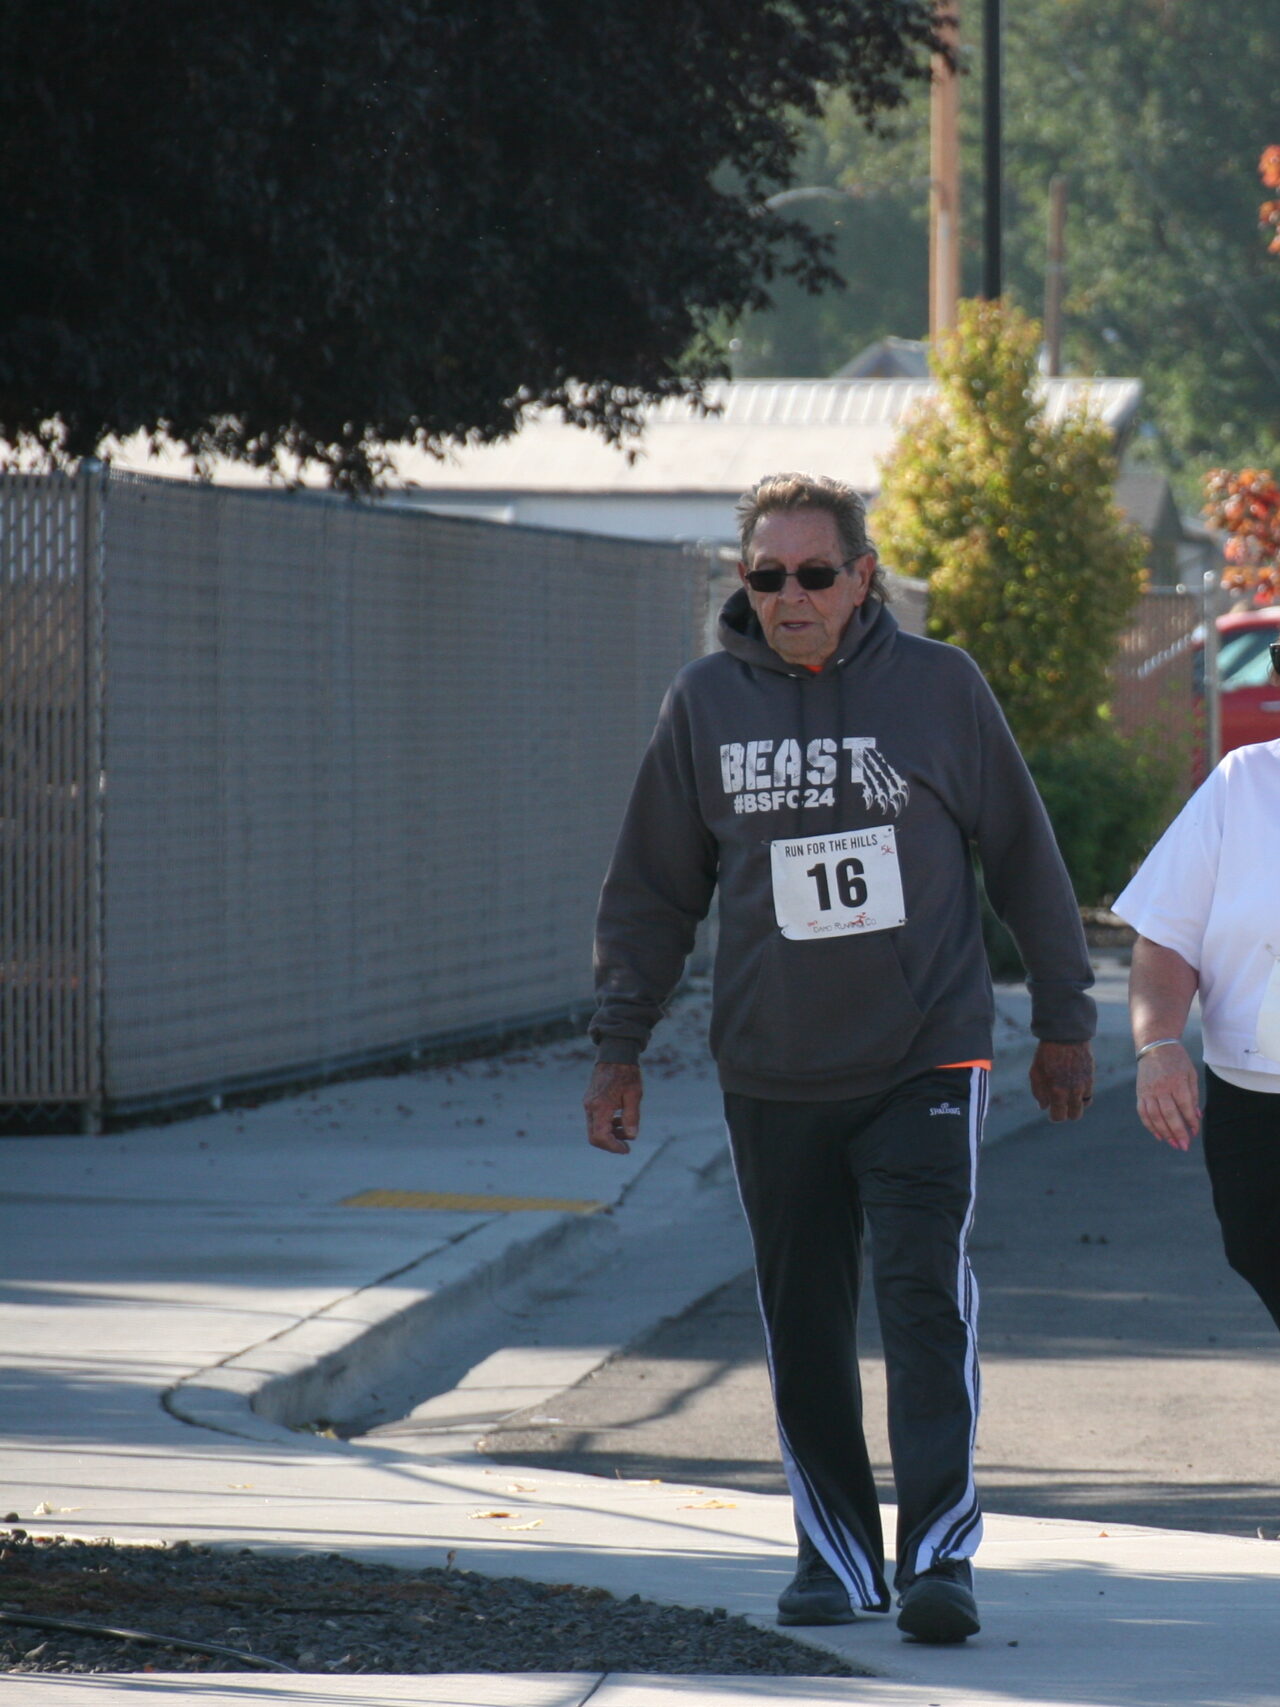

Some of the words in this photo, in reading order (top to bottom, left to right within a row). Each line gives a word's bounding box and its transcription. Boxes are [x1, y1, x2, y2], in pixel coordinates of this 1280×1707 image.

[719, 737, 876, 794] BEAST
[784, 845, 804, 858] RUN
[807, 841, 826, 855] FOR
[828, 838, 848, 852] THE
[850, 834, 878, 849] HILLS
[806, 857, 868, 911] 16
